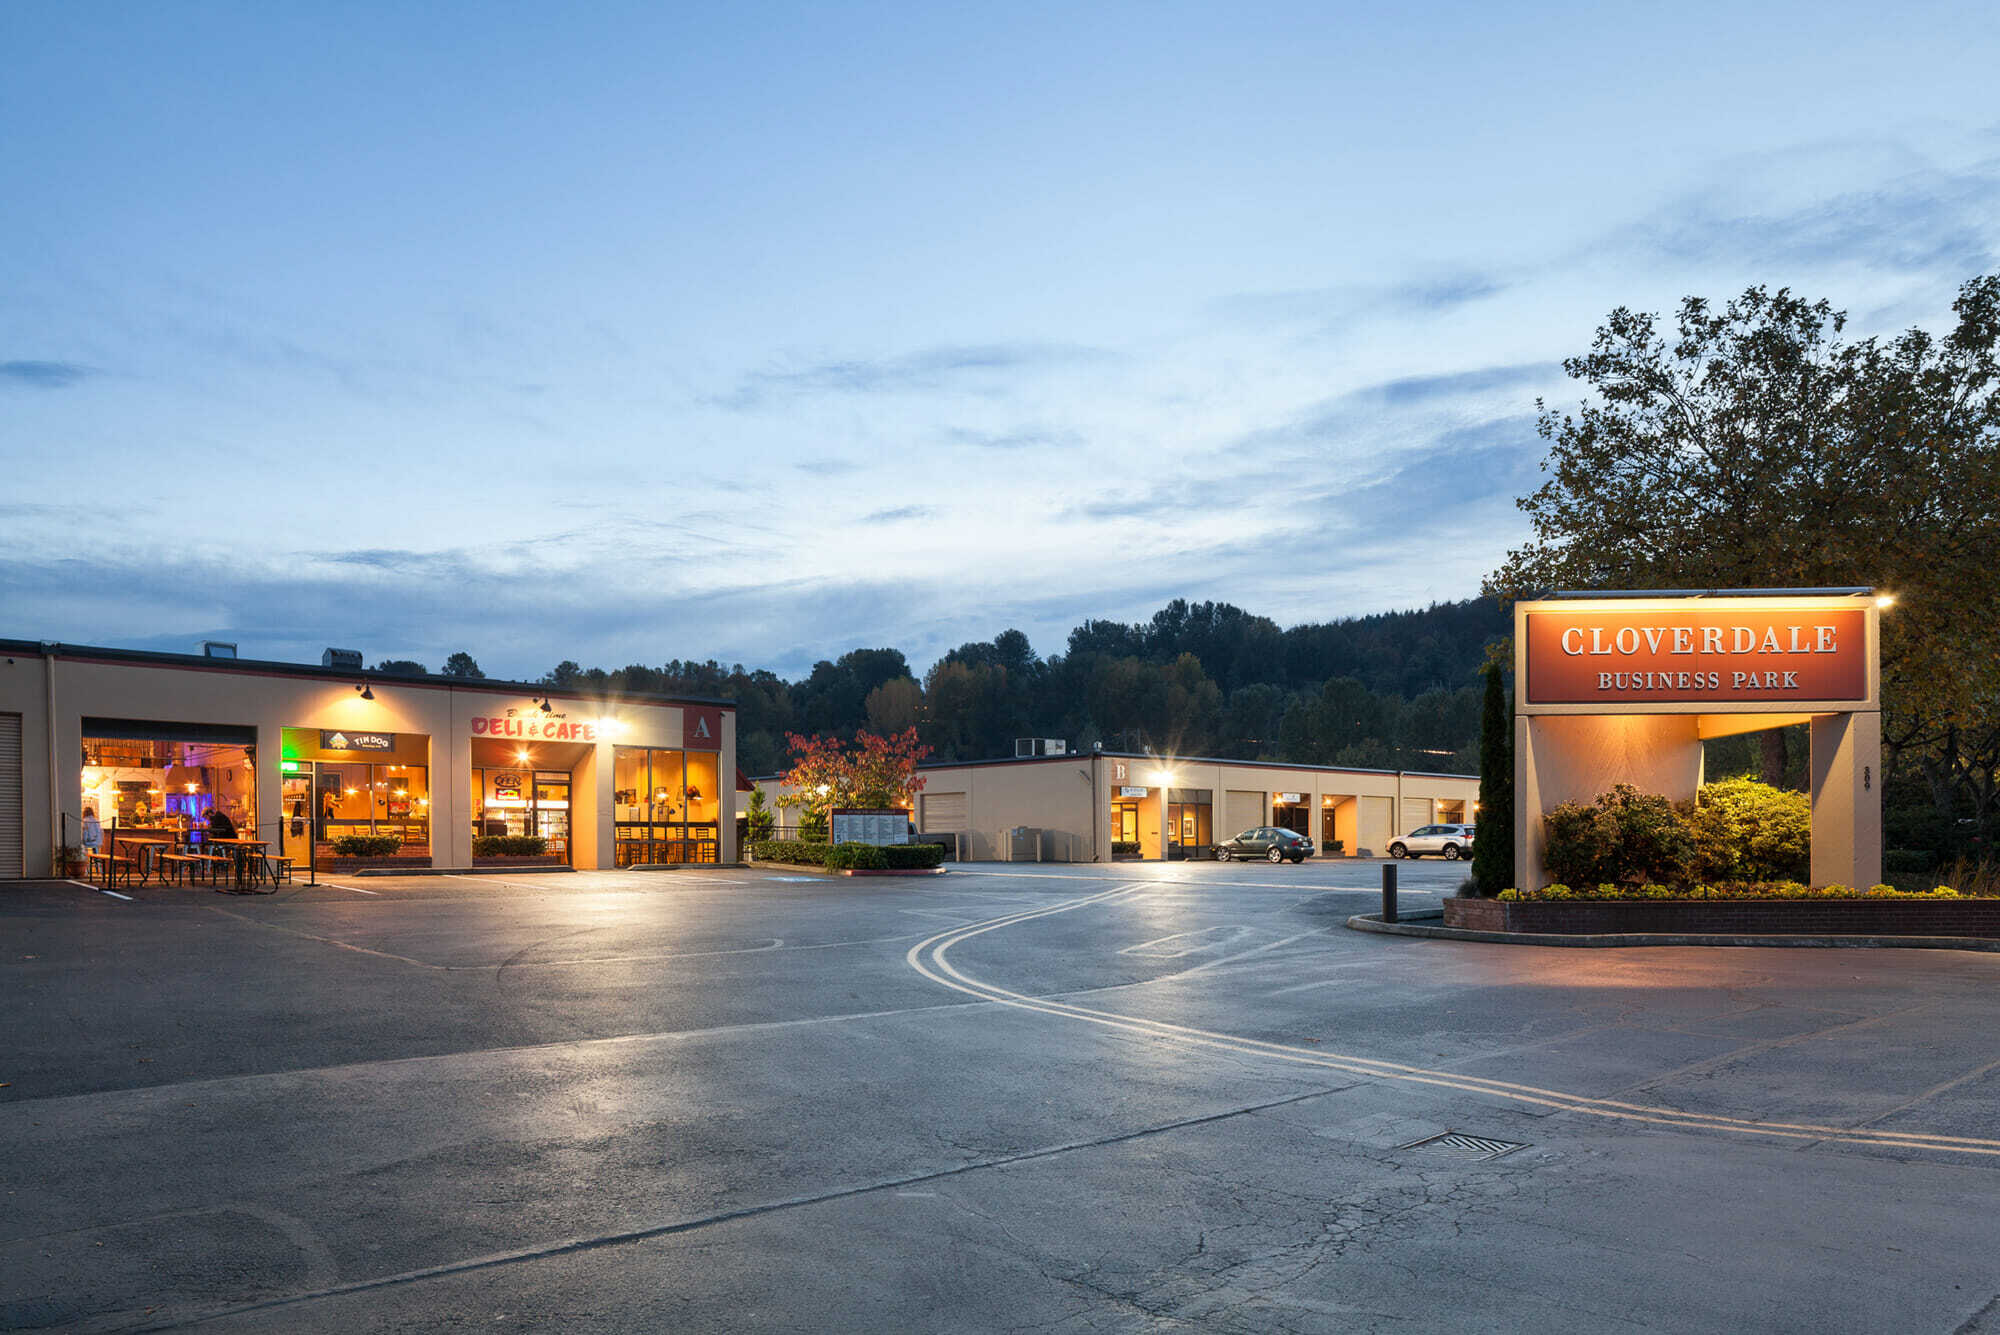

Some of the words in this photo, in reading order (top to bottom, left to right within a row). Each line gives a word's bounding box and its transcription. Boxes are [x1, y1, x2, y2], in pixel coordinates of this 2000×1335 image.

[1561, 626, 1838, 655] CLOVERDALE
[1598, 672, 1719, 691] BUSINESS
[1732, 671, 1800, 690] PARK
[471, 717, 523, 736] DELI
[528, 722, 538, 736] &
[543, 722, 596, 740] CAFE
[693, 715, 712, 738] A
[354, 736, 369, 745] TIN
[370, 736, 388, 747] DOG
[1116, 764, 1125, 779] B
